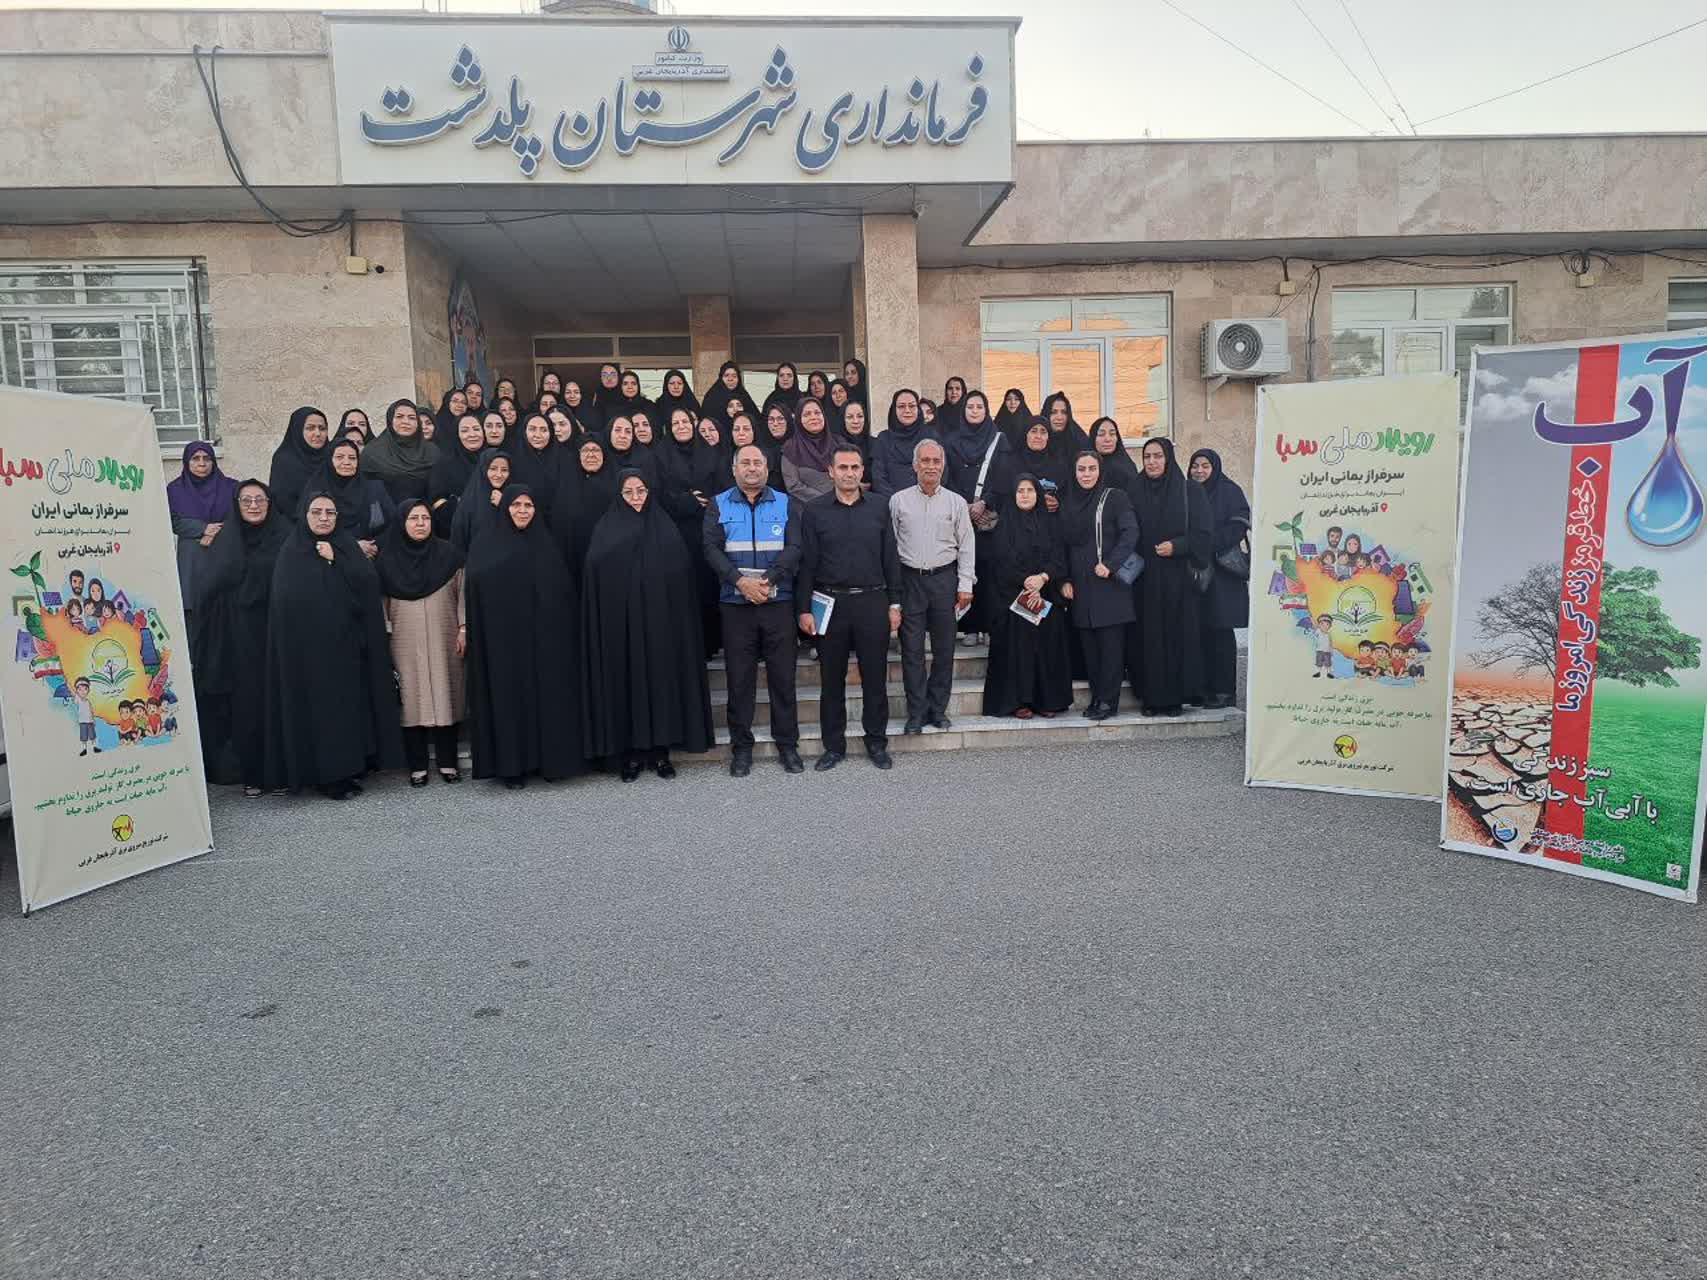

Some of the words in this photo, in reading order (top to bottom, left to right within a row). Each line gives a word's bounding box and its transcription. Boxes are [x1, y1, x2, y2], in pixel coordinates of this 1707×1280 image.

[360, 43, 543, 177] پلدشت
[551, 45, 797, 170] شهرستان
[795, 53, 990, 173] فرمانداری
[1534, 344, 1707, 478] آب
[1320, 426, 1373, 465] ملی
[47, 449, 96, 495] ملی
[1300, 471, 1329, 486] ایران
[1331, 470, 1364, 485] بمانی
[1364, 468, 1405, 484] سرفراز
[32, 501, 60, 519] ایران
[96, 503, 129, 519] سرفراز
[1319, 504, 1339, 517] غربی
[1340, 502, 1380, 516] آذربایجان
[1569, 479, 1596, 524] خط
[58, 543, 77, 558] غربی
[77, 541, 113, 557] آذربایجان
[1567, 524, 1603, 571] قرمز
[1562, 569, 1596, 643] زندگی
[1559, 640, 1592, 695] امروز
[1556, 693, 1581, 711] ما
[1513, 750, 1578, 776] زندگی
[1579, 759, 1611, 782] سبز
[1516, 784, 1569, 808] جاری
[1574, 788, 1606, 811] آب
[1605, 793, 1644, 820] آبی
[1646, 800, 1658, 824] با
